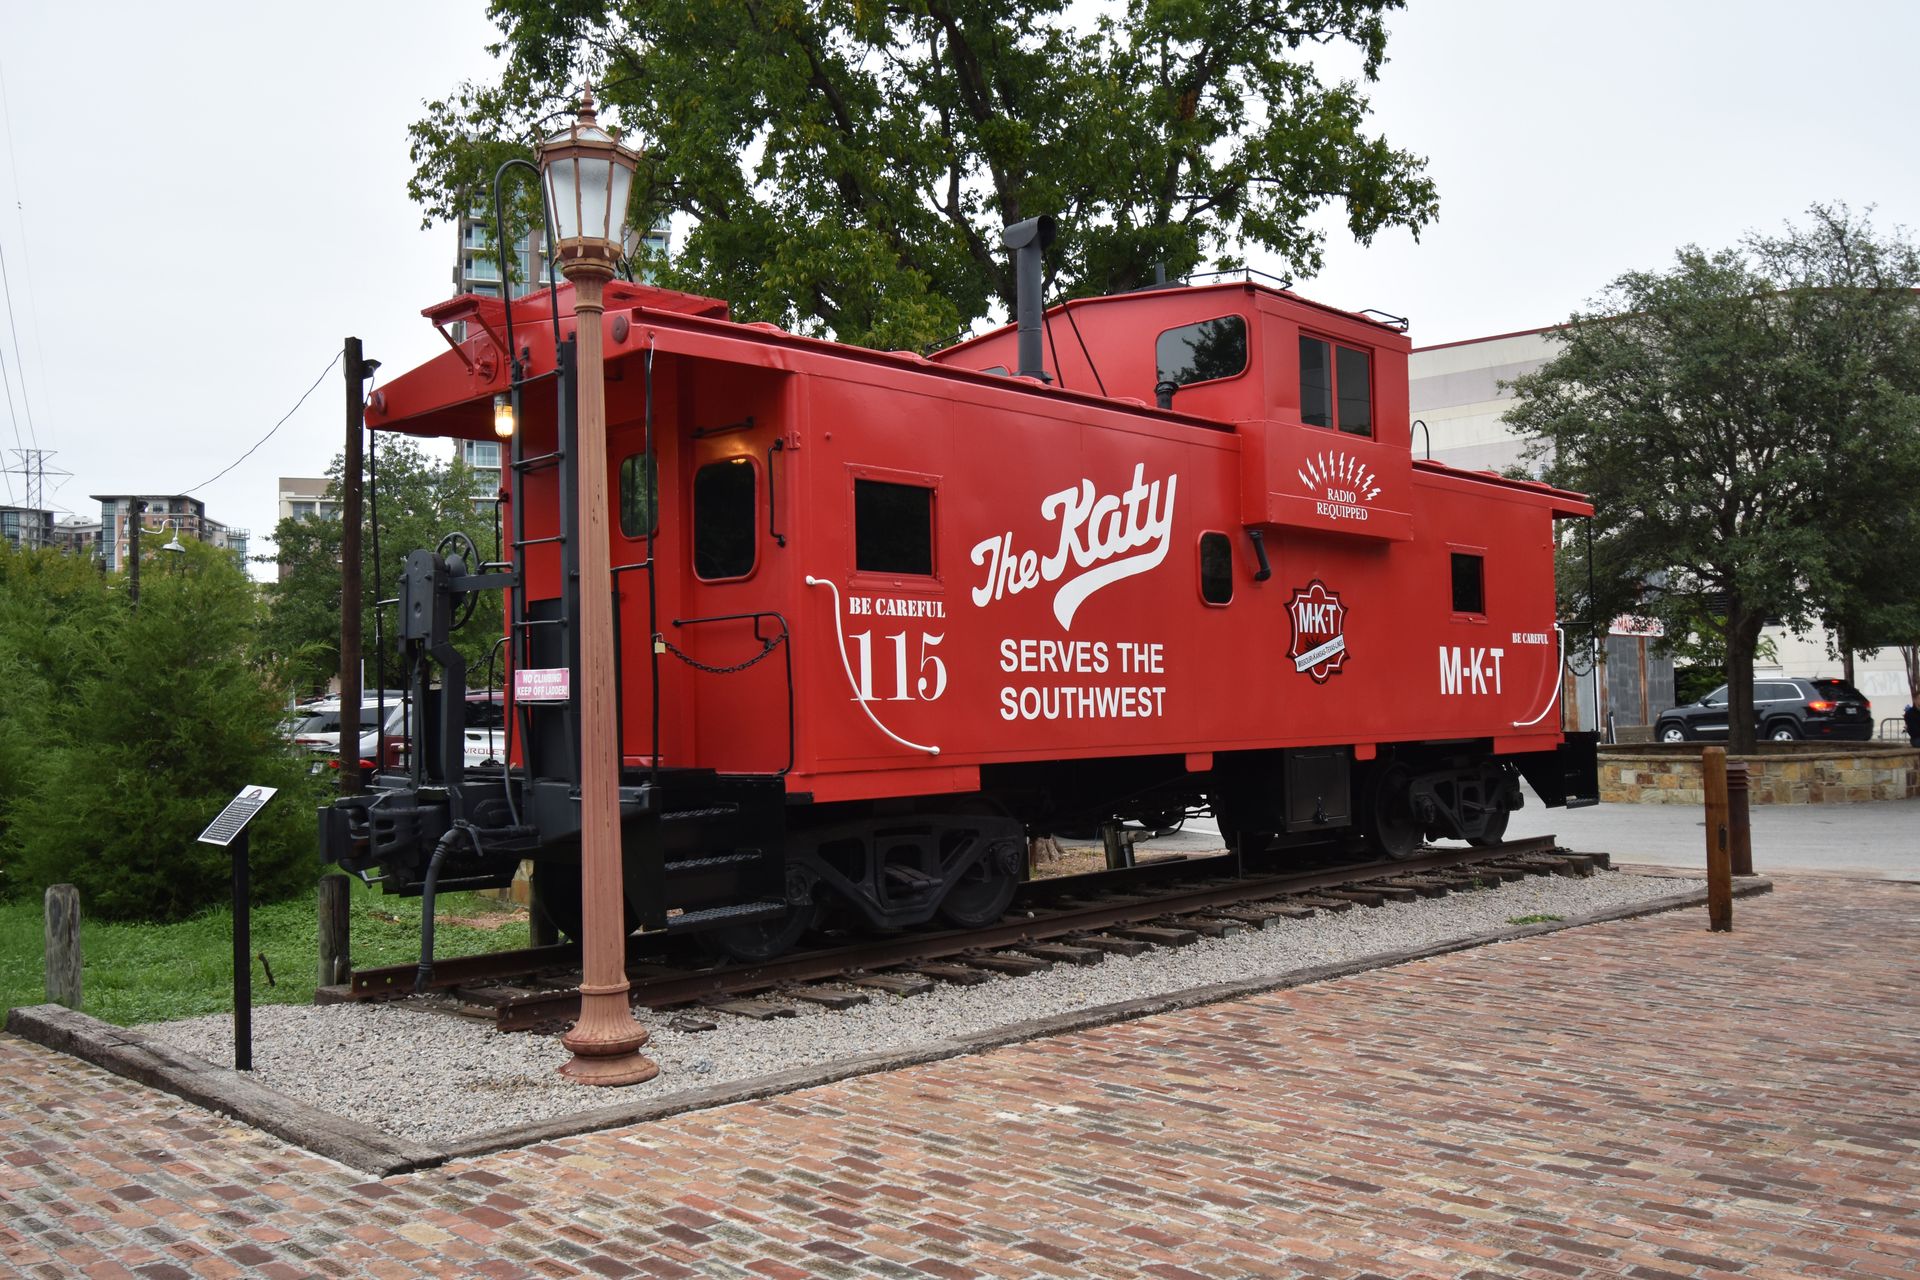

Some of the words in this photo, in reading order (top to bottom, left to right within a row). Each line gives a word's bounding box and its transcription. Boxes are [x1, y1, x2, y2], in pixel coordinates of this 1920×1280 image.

[1327, 488, 1357, 504] RADIO
[1316, 502, 1368, 521] REQUIPPED
[971, 532, 1039, 607] The
[1041, 462, 1177, 631] Katy
[849, 597, 872, 615] BE
[875, 598, 946, 618] CAREFUL
[1512, 632, 1521, 643] BE
[1522, 632, 1549, 644] CAREFUL
[848, 629, 947, 701] 115
[1000, 638, 1109, 674] SERVES
[1116, 642, 1165, 674] THE
[523, 674, 533, 684] NO
[516, 686, 532, 696] KEEP
[532, 686, 545, 696] OFF
[1000, 686, 1167, 720] SOUTHWEST
